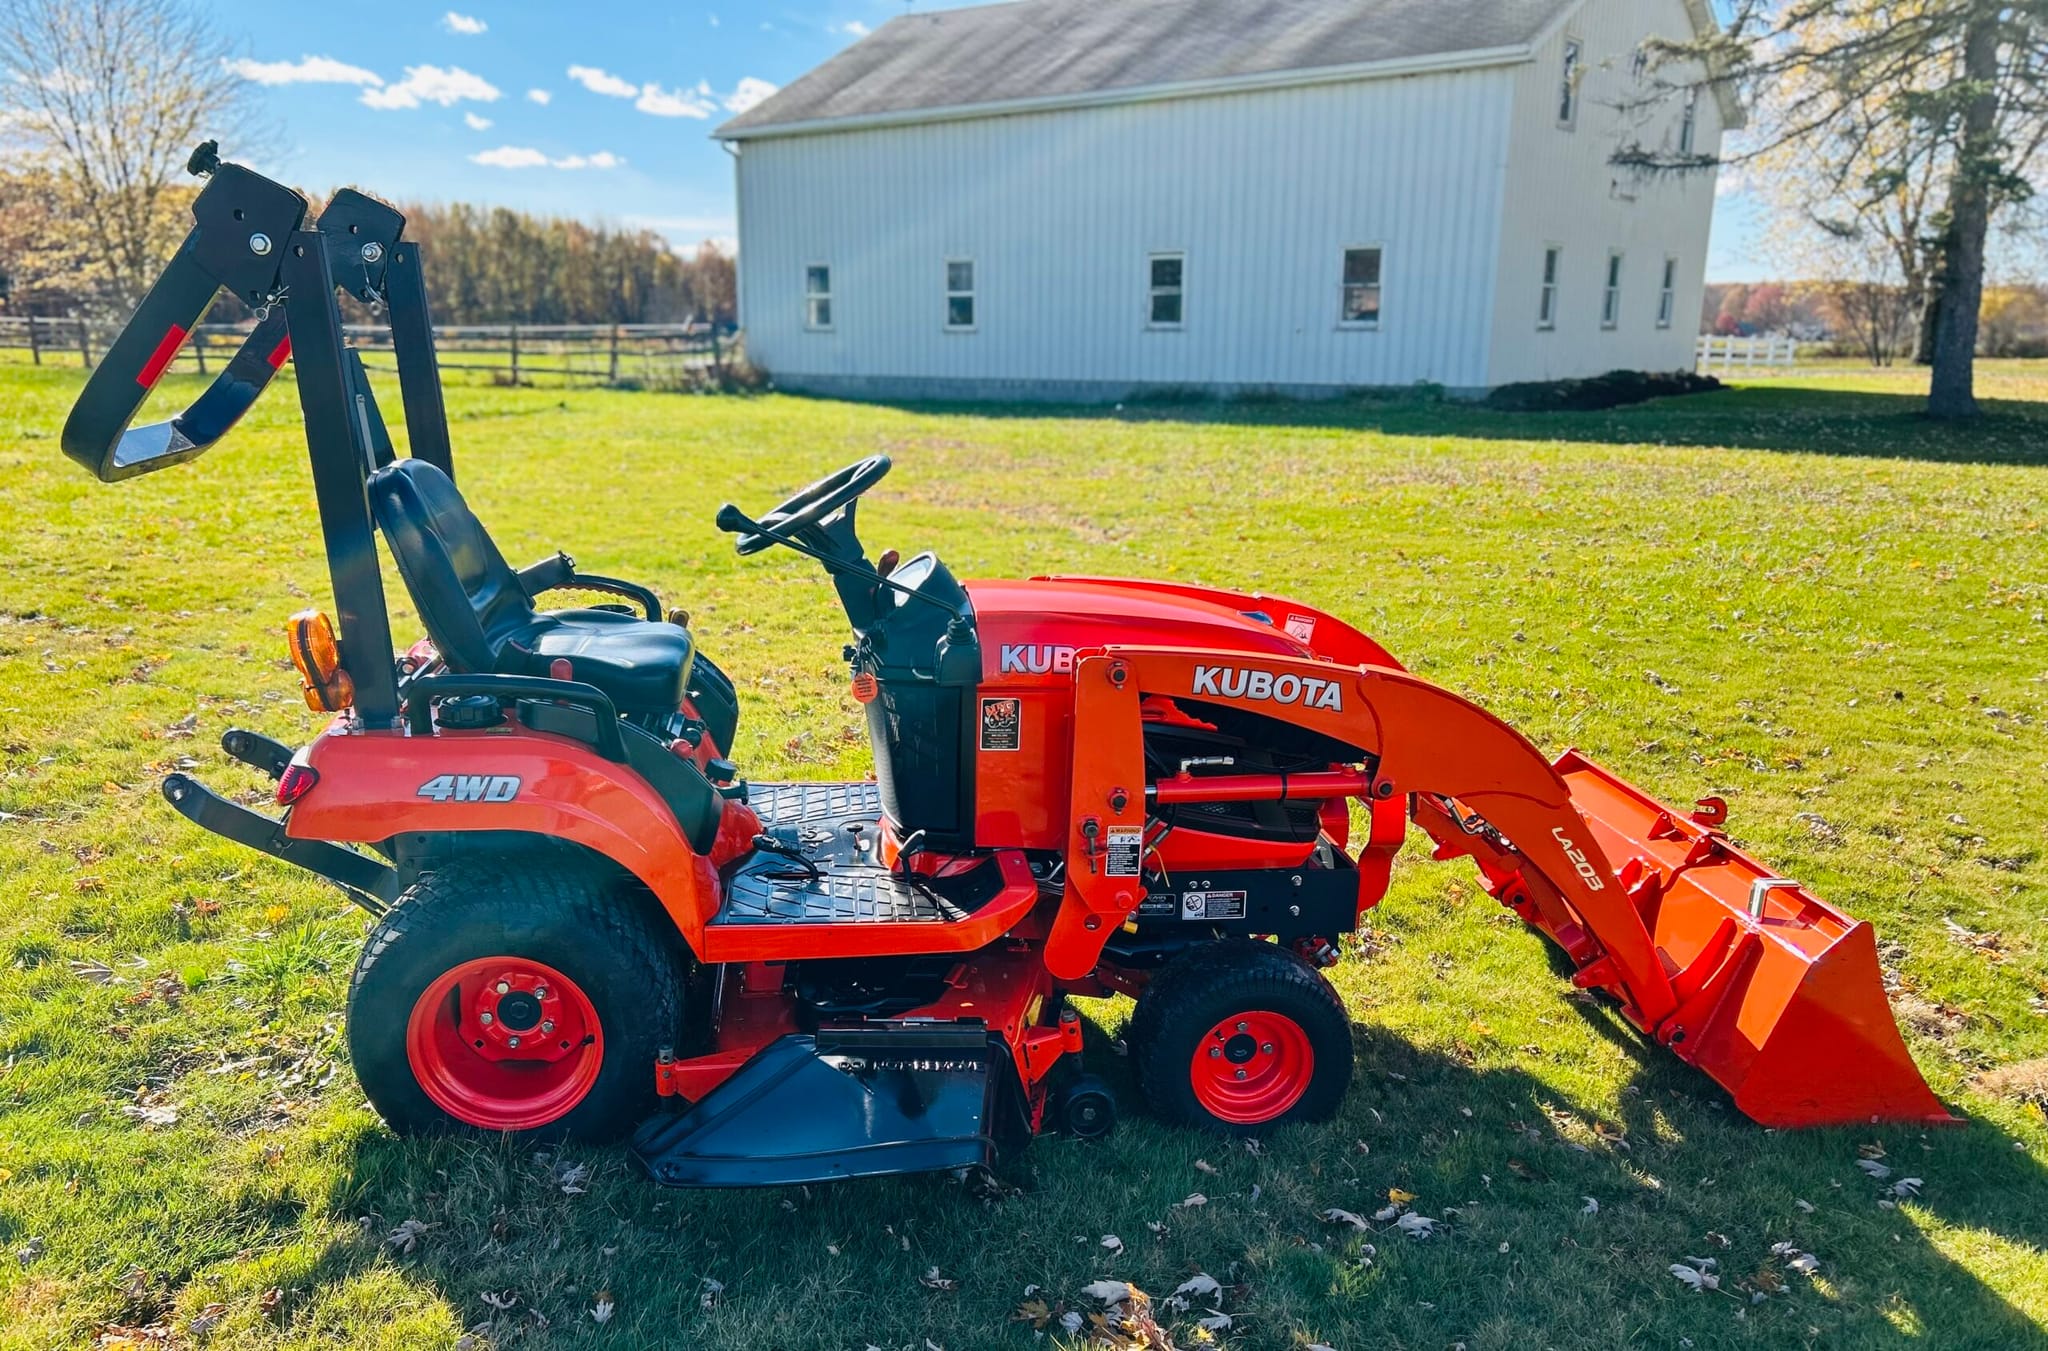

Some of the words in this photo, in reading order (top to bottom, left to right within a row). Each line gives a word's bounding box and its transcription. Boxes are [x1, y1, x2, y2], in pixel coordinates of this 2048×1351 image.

[1192, 665, 1343, 712] KUBOTA
[417, 774, 521, 802] 4WD
[1552, 827, 1604, 891] LA203
